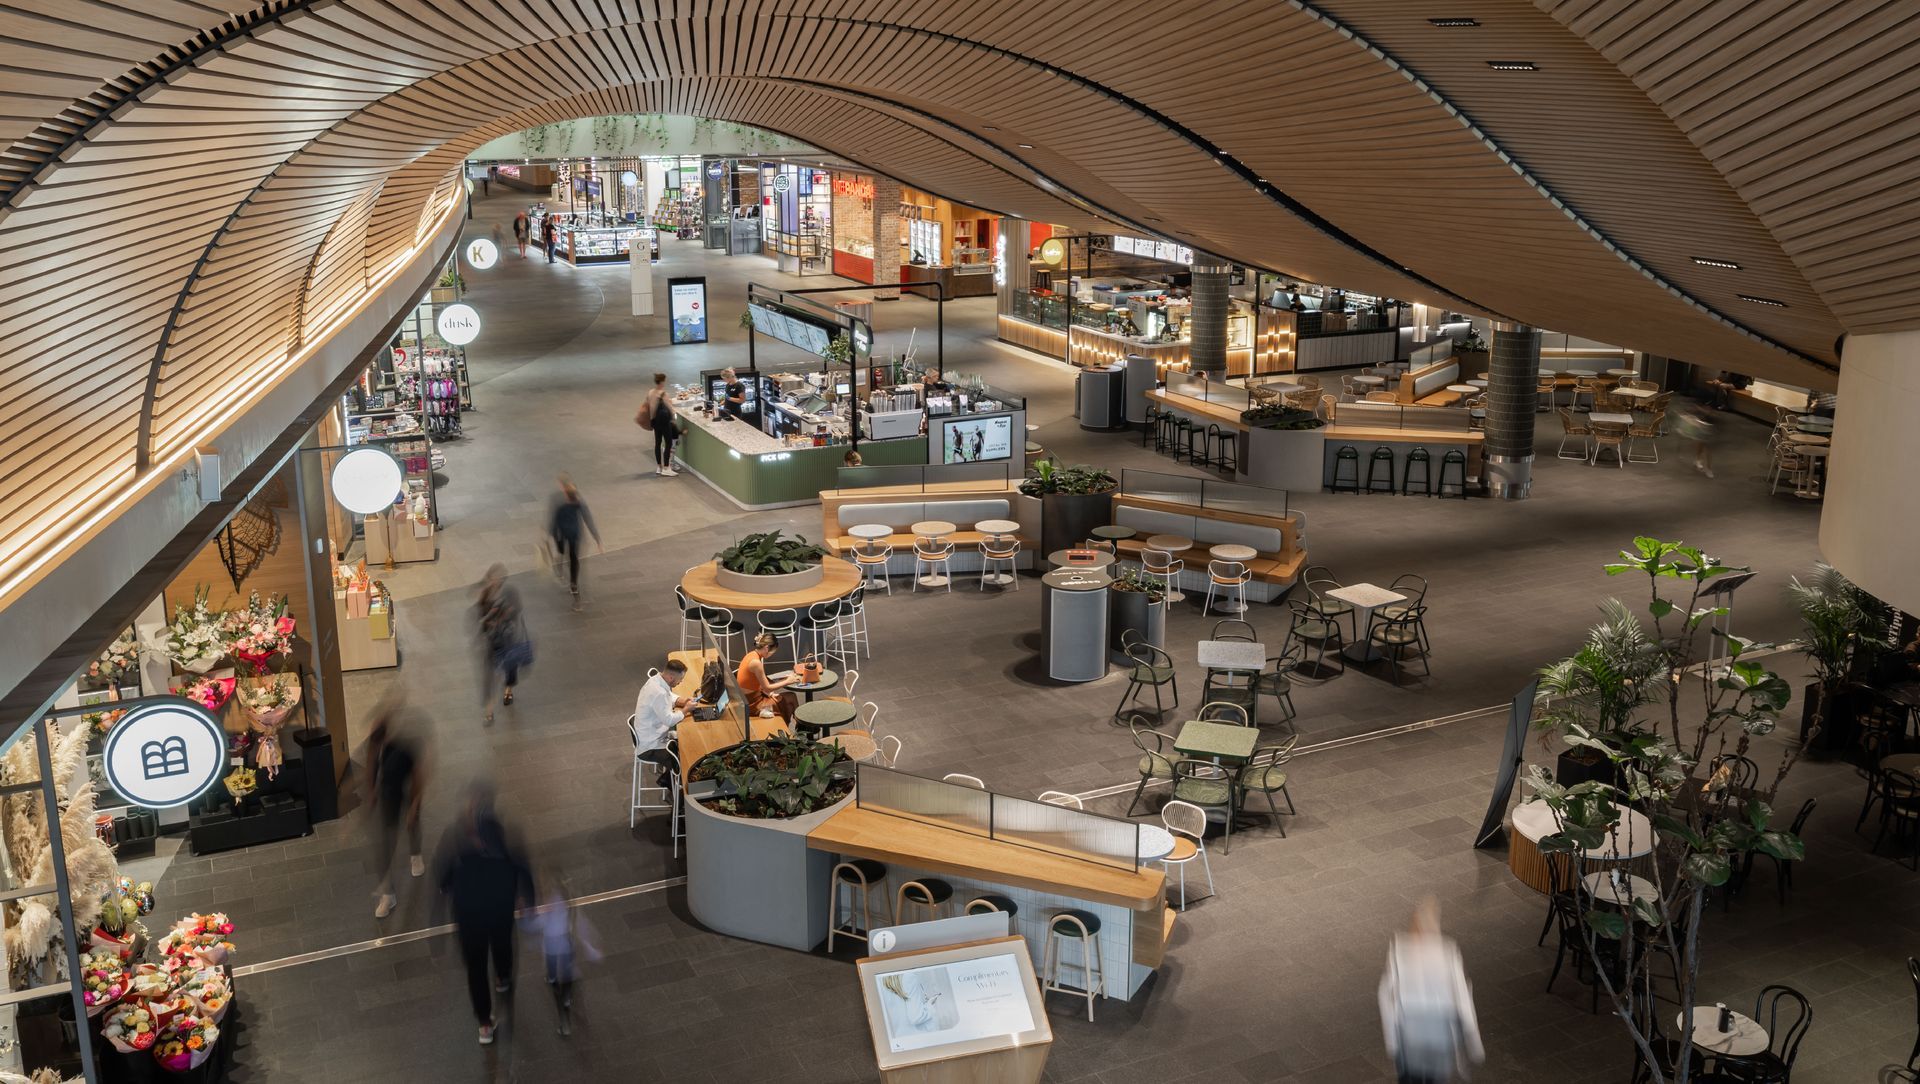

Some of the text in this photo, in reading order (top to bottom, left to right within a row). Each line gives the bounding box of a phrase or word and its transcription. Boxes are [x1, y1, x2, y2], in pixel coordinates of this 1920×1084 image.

[637, 242, 645, 251] G
[473, 246, 484, 262] K
[444, 317, 473, 328] dusk
[760, 454, 776, 462] PICK
